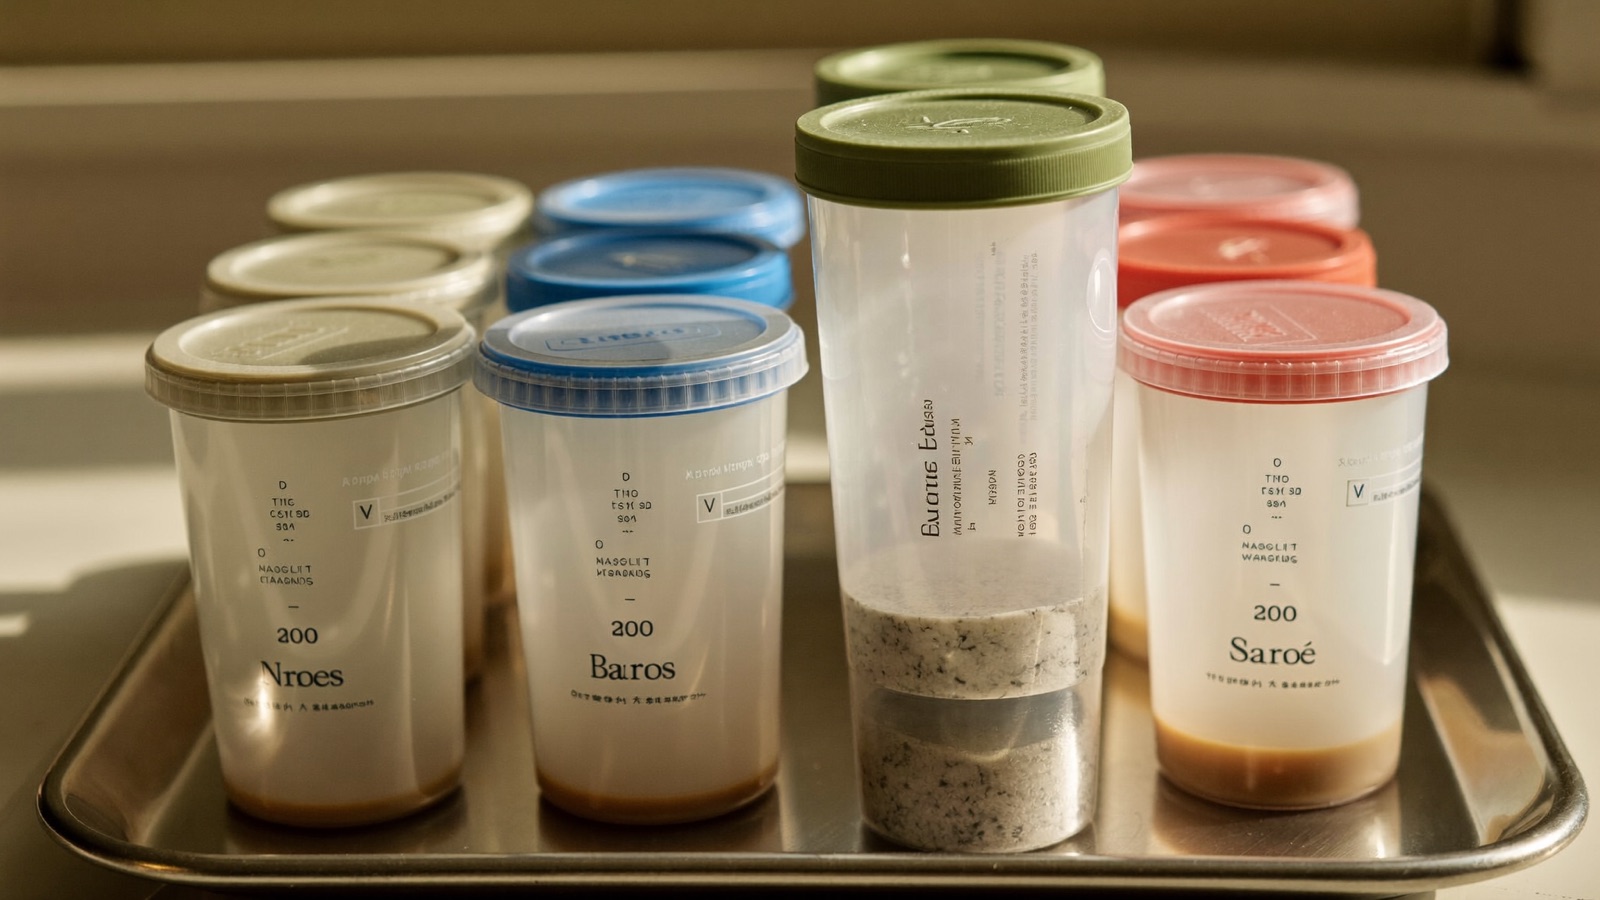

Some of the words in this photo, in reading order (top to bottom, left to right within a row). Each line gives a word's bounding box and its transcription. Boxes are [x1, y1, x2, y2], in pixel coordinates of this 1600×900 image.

[1353, 483, 1366, 499] V
[360, 504, 373, 520] V
[704, 498, 716, 513] V
[1253, 605, 1298, 623] 200
[276, 627, 319, 645] 200
[611, 619, 655, 638] 200
[1229, 636, 1317, 666] Saroé
